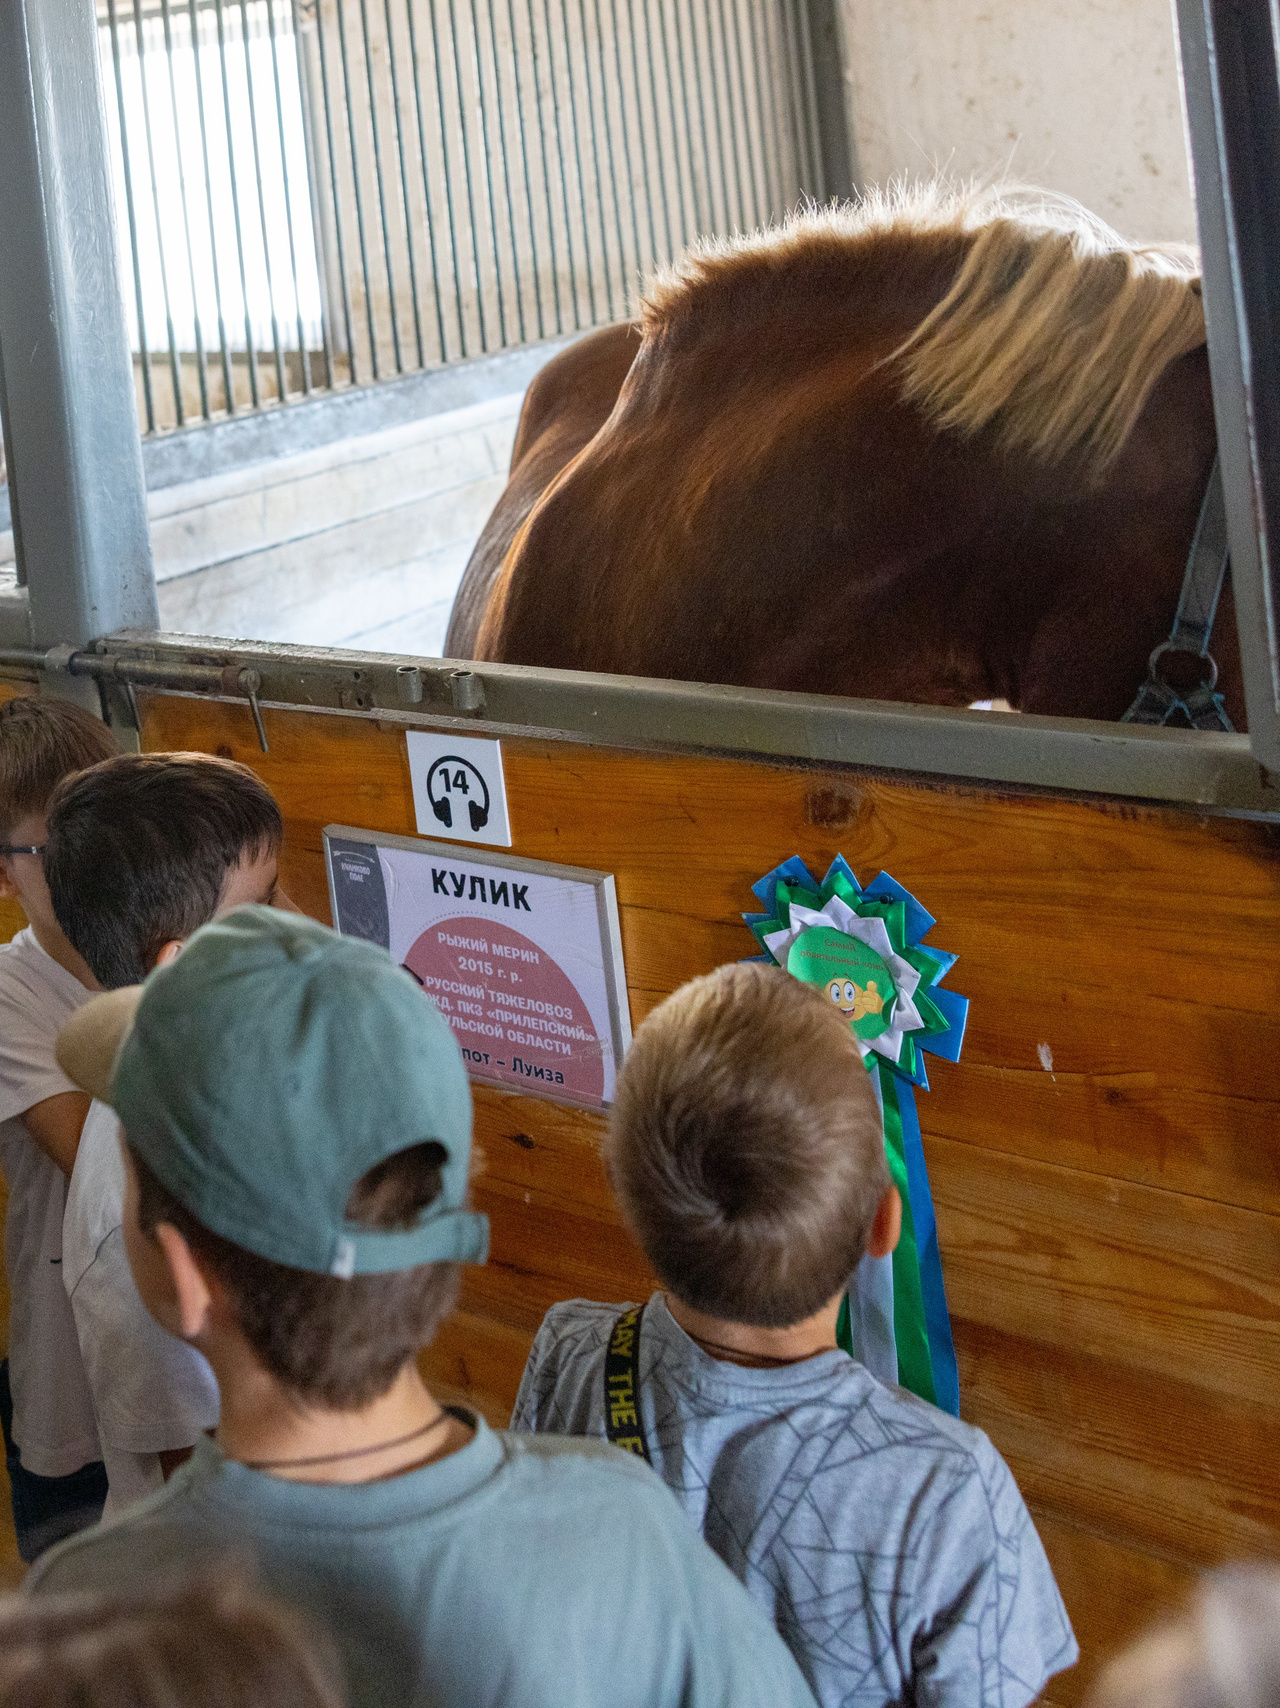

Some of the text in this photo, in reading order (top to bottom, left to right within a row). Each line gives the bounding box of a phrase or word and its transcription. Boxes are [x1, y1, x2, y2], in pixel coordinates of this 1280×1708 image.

[439, 768, 470, 795] 14
[431, 868, 532, 912] КУЛИК
[437, 932, 540, 965] РЫЖИЙ МЕРИН
[458, 956, 523, 984] 2015 г. р.
[426, 976, 573, 1020] РУССКИЙ ТЯЖЕЛОВОЗ
[443, 1015, 572, 1055] УЛЬСКОЙ ОБЛАСТИ
[458, 1000, 483, 1017] ПКЗ
[487, 1009, 595, 1042] «ПРИЛЕПСКИЙ»
[512, 1057, 565, 1084] Луиза
[608, 1367, 638, 1429] THE
